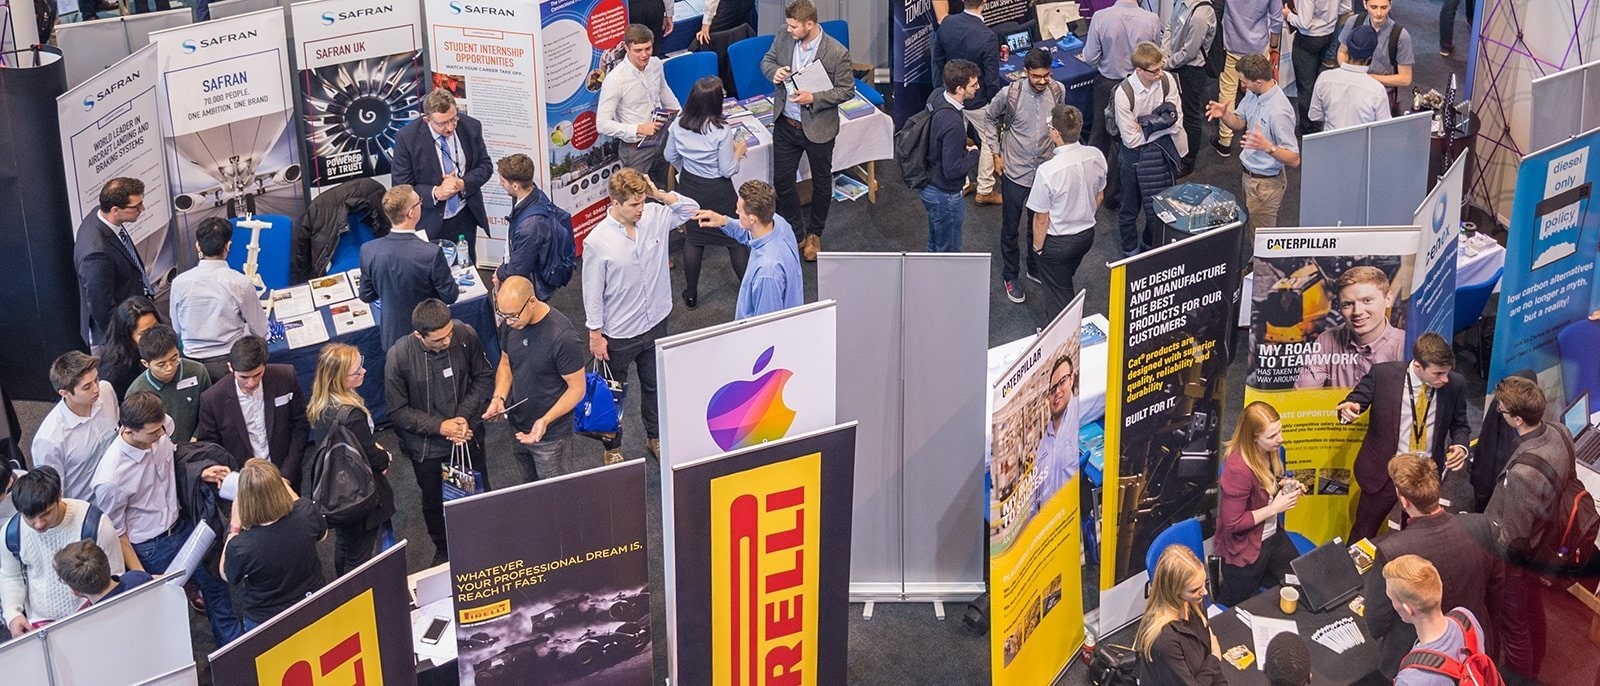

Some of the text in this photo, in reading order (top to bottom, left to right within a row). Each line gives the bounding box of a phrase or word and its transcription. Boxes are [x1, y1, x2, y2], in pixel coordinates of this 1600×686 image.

[338, 5, 392, 20] SAFRAN
[465, 5, 514, 16] SAFRAN
[905, 0, 930, 24] TOMOR
[200, 30, 257, 48] SAFRAN
[316, 42, 366, 59] SAFRAN UK
[444, 42, 524, 57] STUDENT INTERNSHIP
[456, 53, 514, 67] OPPORTUNITIES
[96, 70, 140, 102] SAFRAN
[202, 71, 248, 92] SAFRAN
[188, 112, 200, 120] ONE
[248, 95, 268, 105] BRAND
[88, 122, 149, 167] AIRCRAFT LANDING AND
[93, 115, 141, 152] WORLD LEADER IN
[96, 153, 119, 174] BRAKING
[119, 136, 144, 158] SYSTEMS
[326, 154, 362, 167] POWERED
[1553, 153, 1582, 174] diesel
[328, 162, 362, 176] BY TRUST
[1555, 176, 1576, 191] only
[1544, 209, 1575, 232] policy
[1267, 238, 1337, 250] CATERPILLAR
[1130, 264, 1185, 292] WE DESIGN
[1130, 290, 1151, 306] AND
[1154, 263, 1226, 298] MANUFACTURE
[1507, 262, 1594, 304] low carbon alternatives
[1130, 294, 1175, 320] THE BEST
[1510, 304, 1522, 318] are
[1522, 300, 1533, 310] no
[1534, 289, 1559, 305] longer
[1566, 278, 1588, 290] myth,
[1524, 311, 1536, 323] but
[1544, 296, 1570, 316] reality!
[1130, 306, 1180, 334] PRODUCTS
[1182, 298, 1200, 313] FOR
[1202, 291, 1222, 306] OUR
[1129, 316, 1187, 347] CUSTOMERS
[1127, 340, 1216, 380] designed with superior
[1146, 342, 1180, 363] products
[1181, 336, 1194, 347] are
[1258, 353, 1359, 368] TO TEAMWORK
[1260, 342, 1322, 356] MY ROAD
[1002, 347, 1042, 398] CATERPILLAR
[1127, 351, 1210, 392] quality, reliability and
[1127, 381, 1163, 403] durability
[1125, 396, 1177, 428] BUILT FOR IT.
[1297, 410, 1338, 419] OPPORTUN
[1003, 492, 1017, 516] MY
[1001, 510, 1015, 528] TO
[456, 560, 524, 583] WHATEVER
[457, 579, 492, 592] YOUR
[494, 555, 583, 585] PROFESSIONAL
[586, 545, 628, 561] DREAM
[458, 575, 546, 602] REACH IT FAST.
